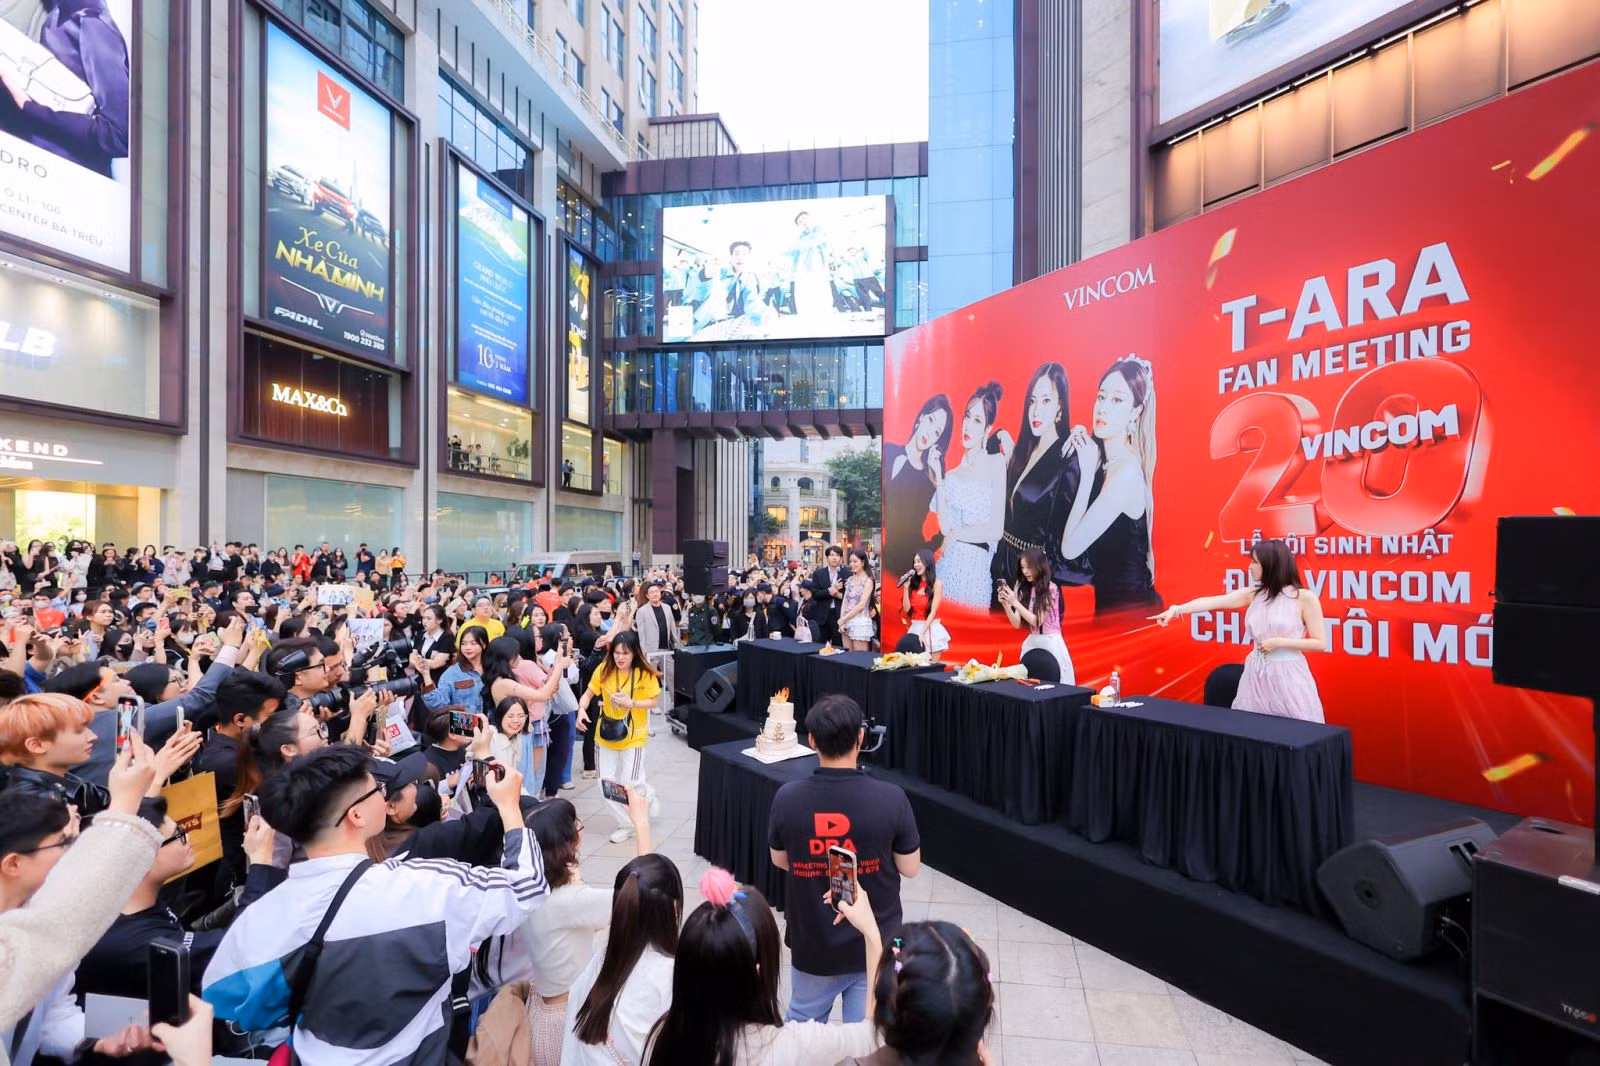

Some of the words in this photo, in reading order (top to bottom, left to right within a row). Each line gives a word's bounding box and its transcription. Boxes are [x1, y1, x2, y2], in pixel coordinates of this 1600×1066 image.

[294, 226, 324, 253] Xe
[1063, 263, 1157, 311] VINCOM
[1221, 241, 1470, 353] T-ARA
[274, 306, 324, 330] FADIL
[344, 331, 360, 343] 1900
[1218, 357, 1278, 395] FAN
[1291, 319, 1471, 382] MEETING
[1300, 403, 1461, 461] VINCOM
[1314, 536, 1372, 555] SINH
[1382, 528, 1454, 560] NHẬT
[1303, 569, 1471, 605] VINCOM
